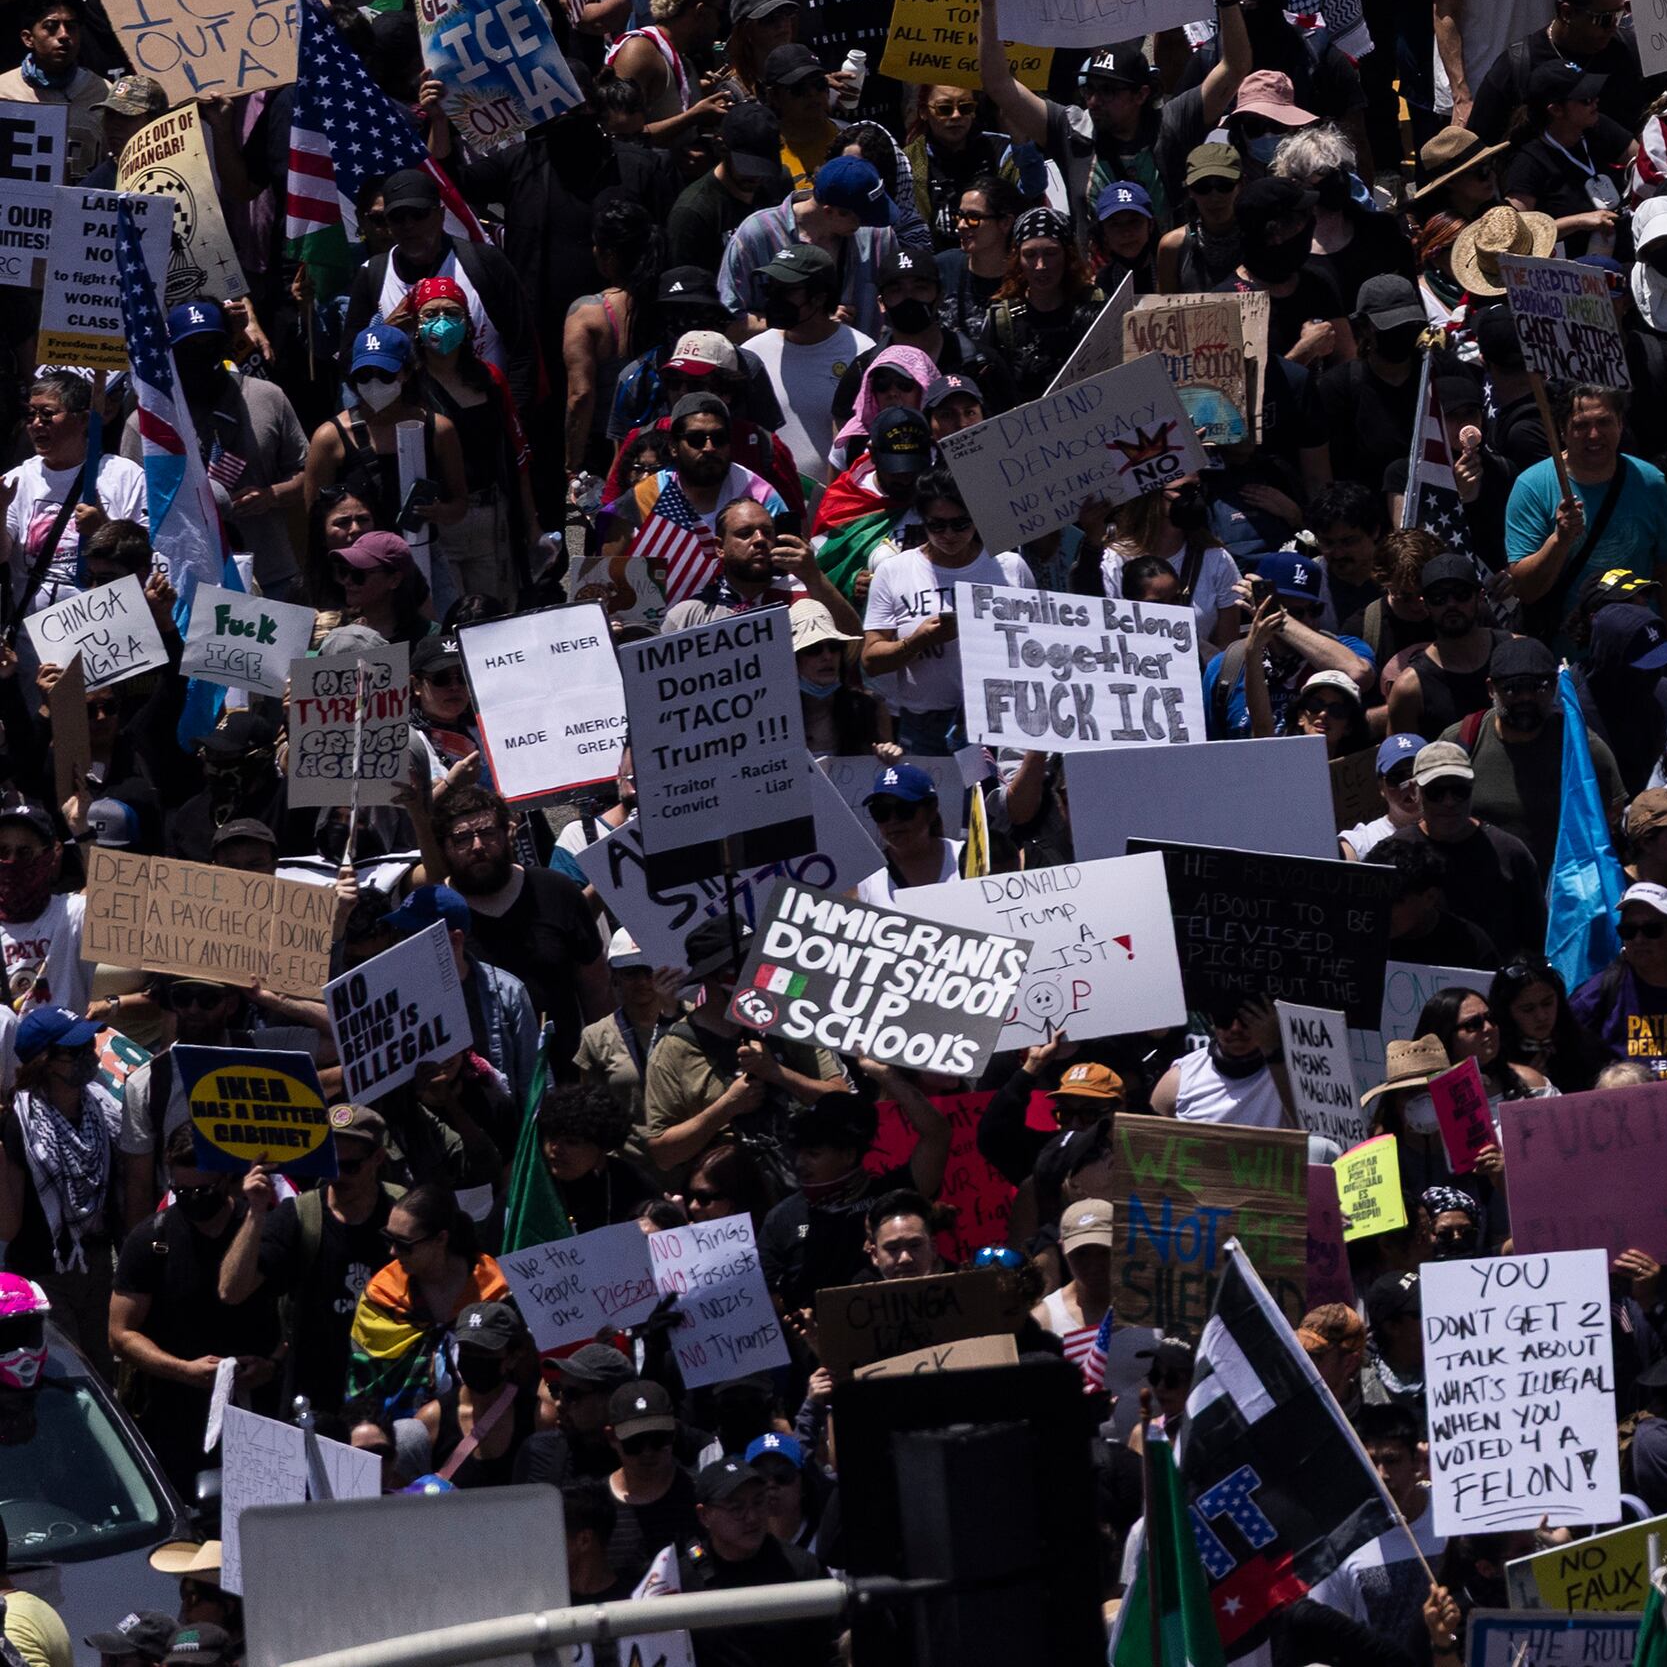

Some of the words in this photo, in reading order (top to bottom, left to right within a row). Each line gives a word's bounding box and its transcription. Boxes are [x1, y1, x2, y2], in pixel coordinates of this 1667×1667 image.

[971, 584, 1090, 627] Families
[1102, 598, 1193, 653] Belong
[485, 651, 525, 669] HATE
[550, 636, 599, 654] NEVER
[994, 623, 1173, 682] Together
[505, 731, 548, 749] MADE
[565, 716, 629, 736] AMERICA
[984, 679, 1100, 741] FUCK
[1108, 683, 1189, 743] ICE
[577, 735, 628, 755] GREAT
[778, 886, 1028, 988] IMMIGRANTS
[830, 978, 910, 1025] UP
[882, 958, 1018, 1018] SHOOT
[1471, 1258, 1549, 1298] YOU
[1426, 1307, 1497, 1344] DON'T
[1505, 1301, 1567, 1336] GET
[1578, 1302, 1605, 1328] 2
[1436, 1346, 1509, 1371] TALK
[1518, 1334, 1603, 1363] ABOUT
[1433, 1375, 1505, 1408] WHAT'S
[1518, 1365, 1615, 1398] ILLEGAL
[1431, 1411, 1501, 1443] WHEN
[1512, 1400, 1561, 1429] YOU
[1435, 1437, 1512, 1472] VOTED
[1520, 1429, 1541, 1453] 4
[1559, 1426, 1582, 1449] A
[1451, 1448, 1599, 1513] FELON!
